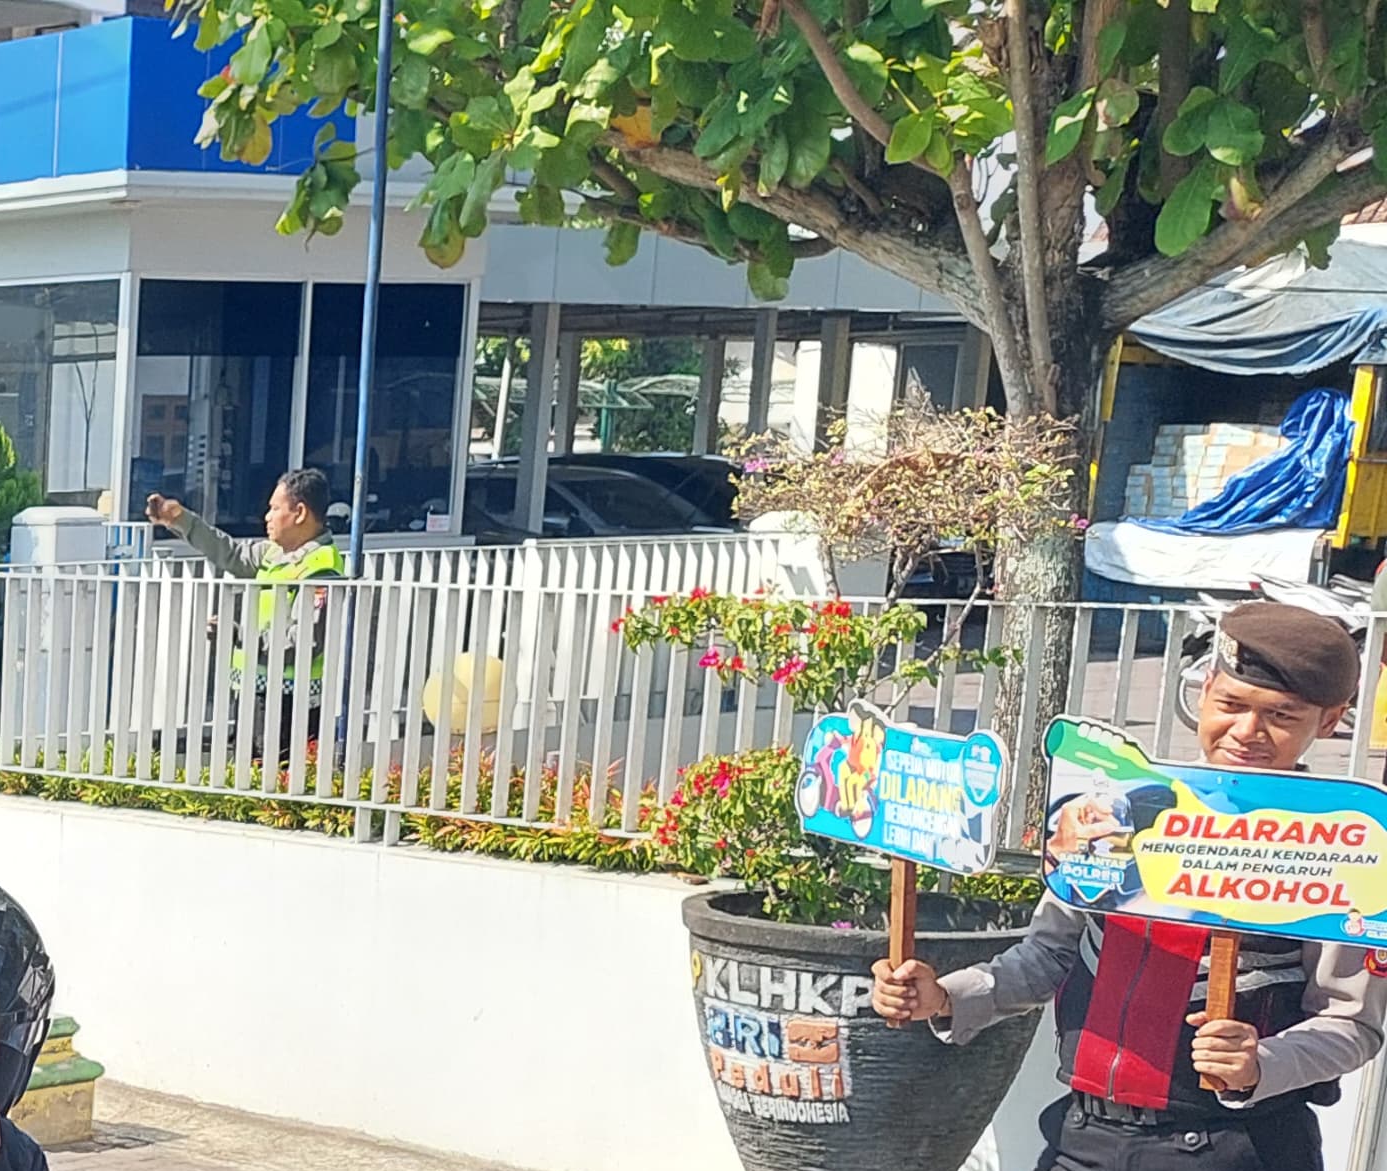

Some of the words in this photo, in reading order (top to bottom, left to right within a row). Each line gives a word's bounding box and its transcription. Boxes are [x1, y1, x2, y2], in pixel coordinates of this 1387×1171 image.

[1163, 813, 1367, 847] DILARANG
[1141, 842, 1269, 860] MENGGENDARAI
[1273, 848, 1379, 865] KENDARAAN
[1062, 863, 1121, 882] POLRES
[1181, 859, 1238, 872] DALAM
[1241, 862, 1333, 878] PENGARUH
[1167, 873, 1352, 907] ALKOHOL
